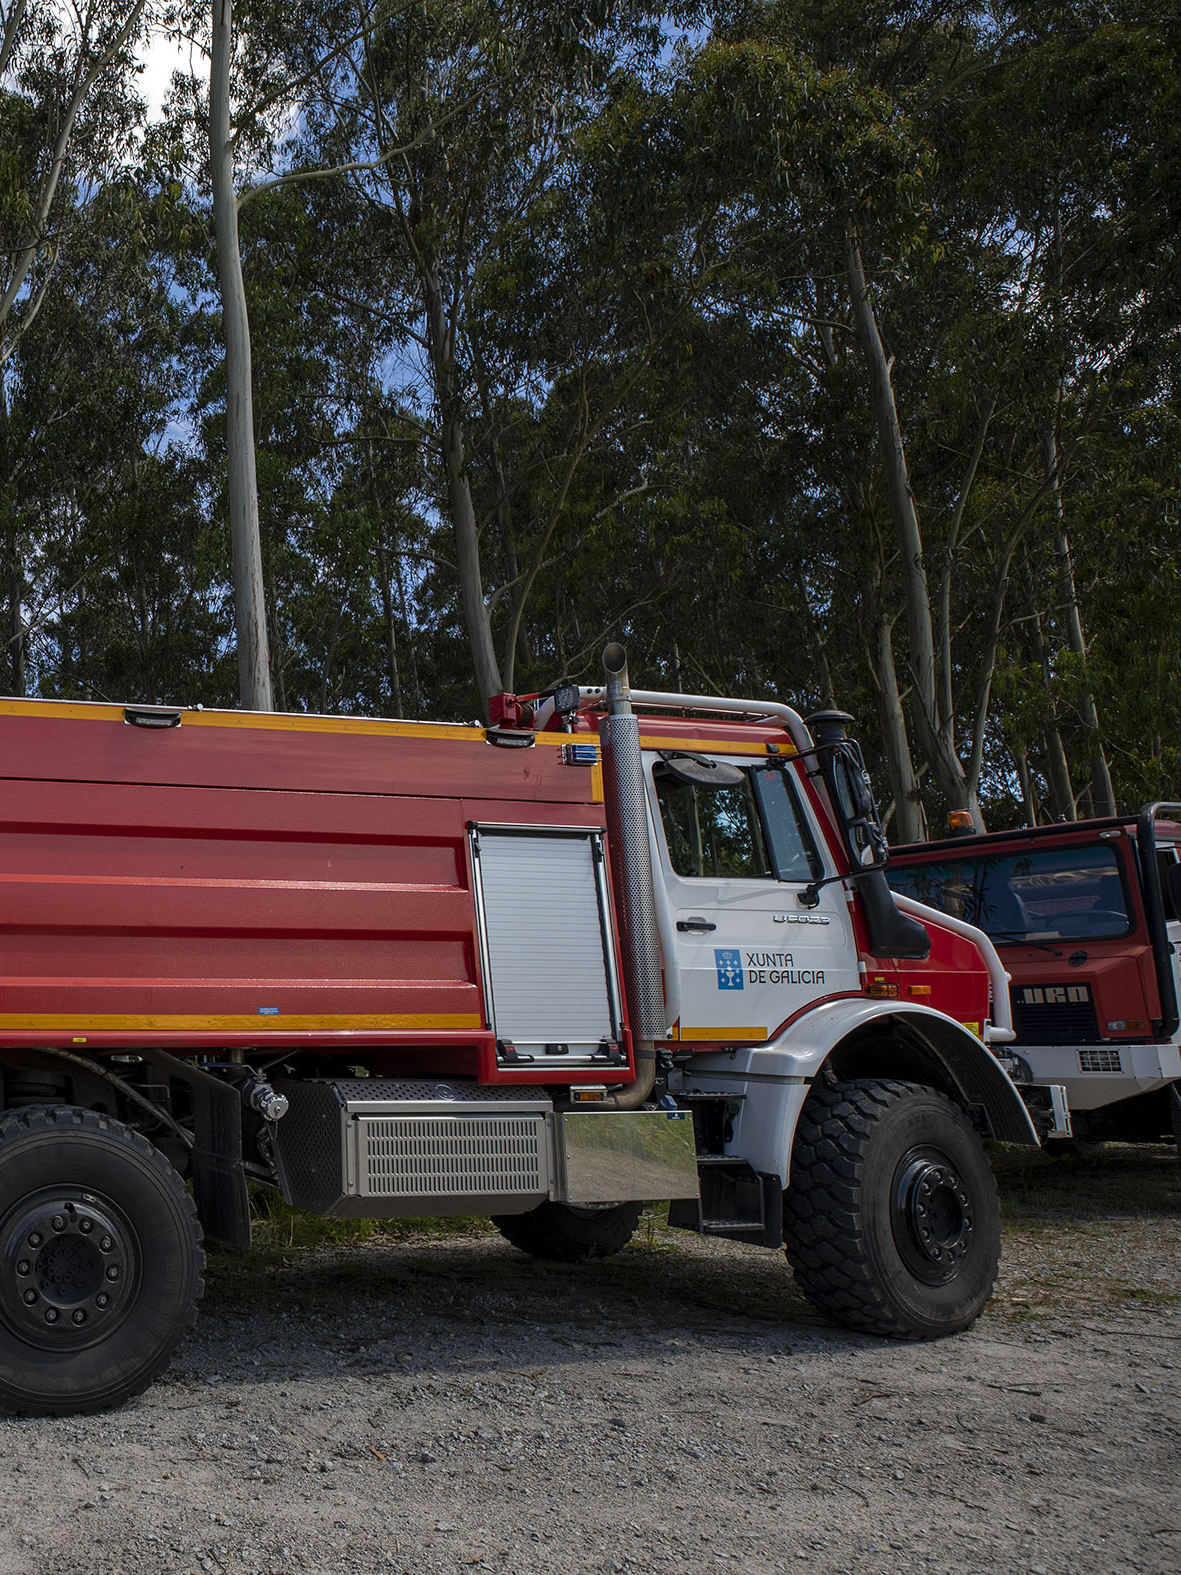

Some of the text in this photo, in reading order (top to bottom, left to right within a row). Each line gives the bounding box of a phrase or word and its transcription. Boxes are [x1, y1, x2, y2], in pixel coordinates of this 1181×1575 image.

[746, 953, 794, 967] XUNTA
[749, 970, 825, 984] DE GALICIA
[1023, 986, 1089, 1004] URO
